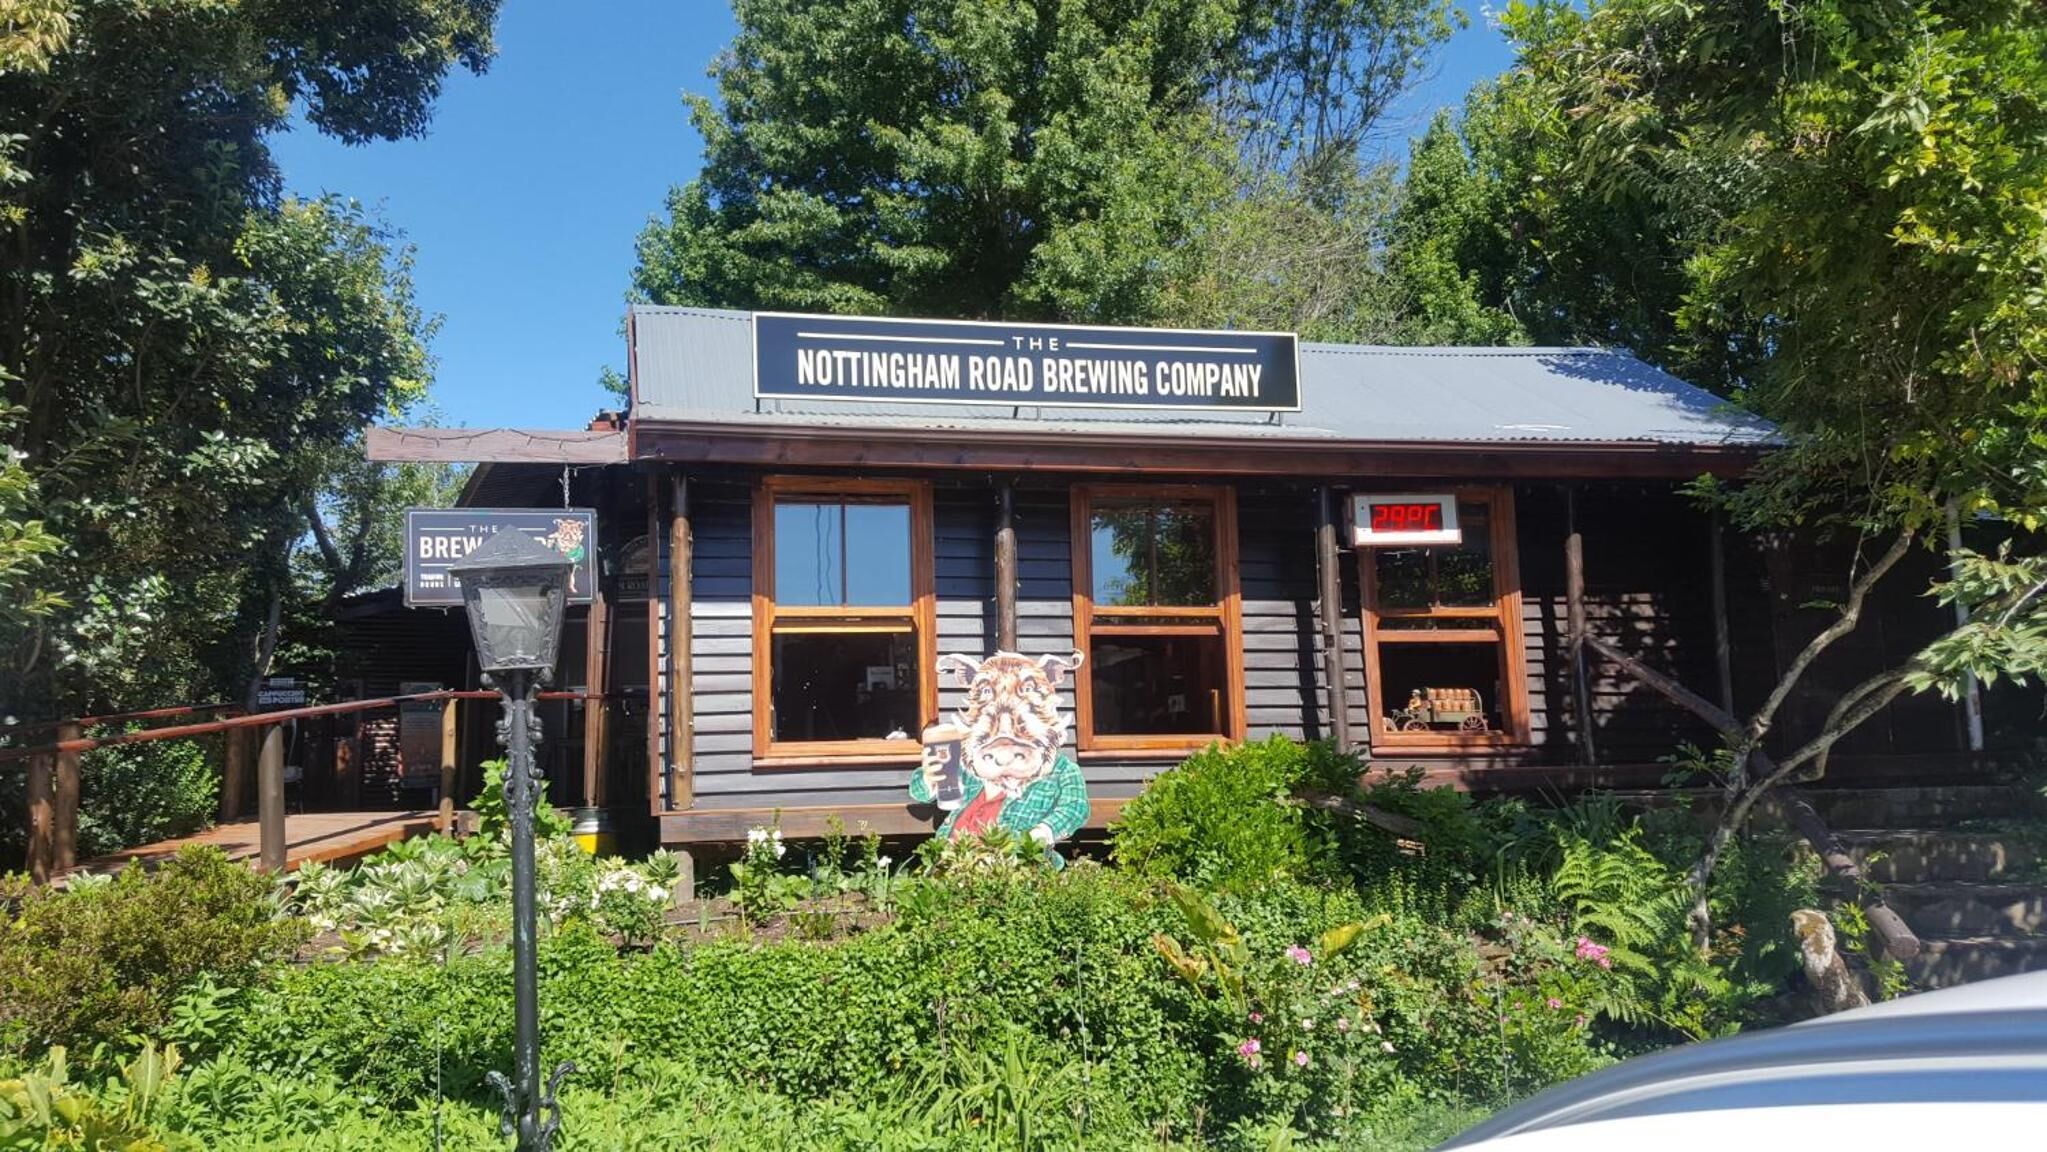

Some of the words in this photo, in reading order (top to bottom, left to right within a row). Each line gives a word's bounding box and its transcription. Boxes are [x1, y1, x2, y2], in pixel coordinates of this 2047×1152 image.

[1011, 335, 1060, 352] THE
[797, 348, 961, 390] NOTTINGHAM
[968, 355, 1034, 392] ROAD
[1042, 357, 1149, 396] BREWING
[1155, 360, 1263, 398] COMPANY
[469, 524, 498, 534] THE
